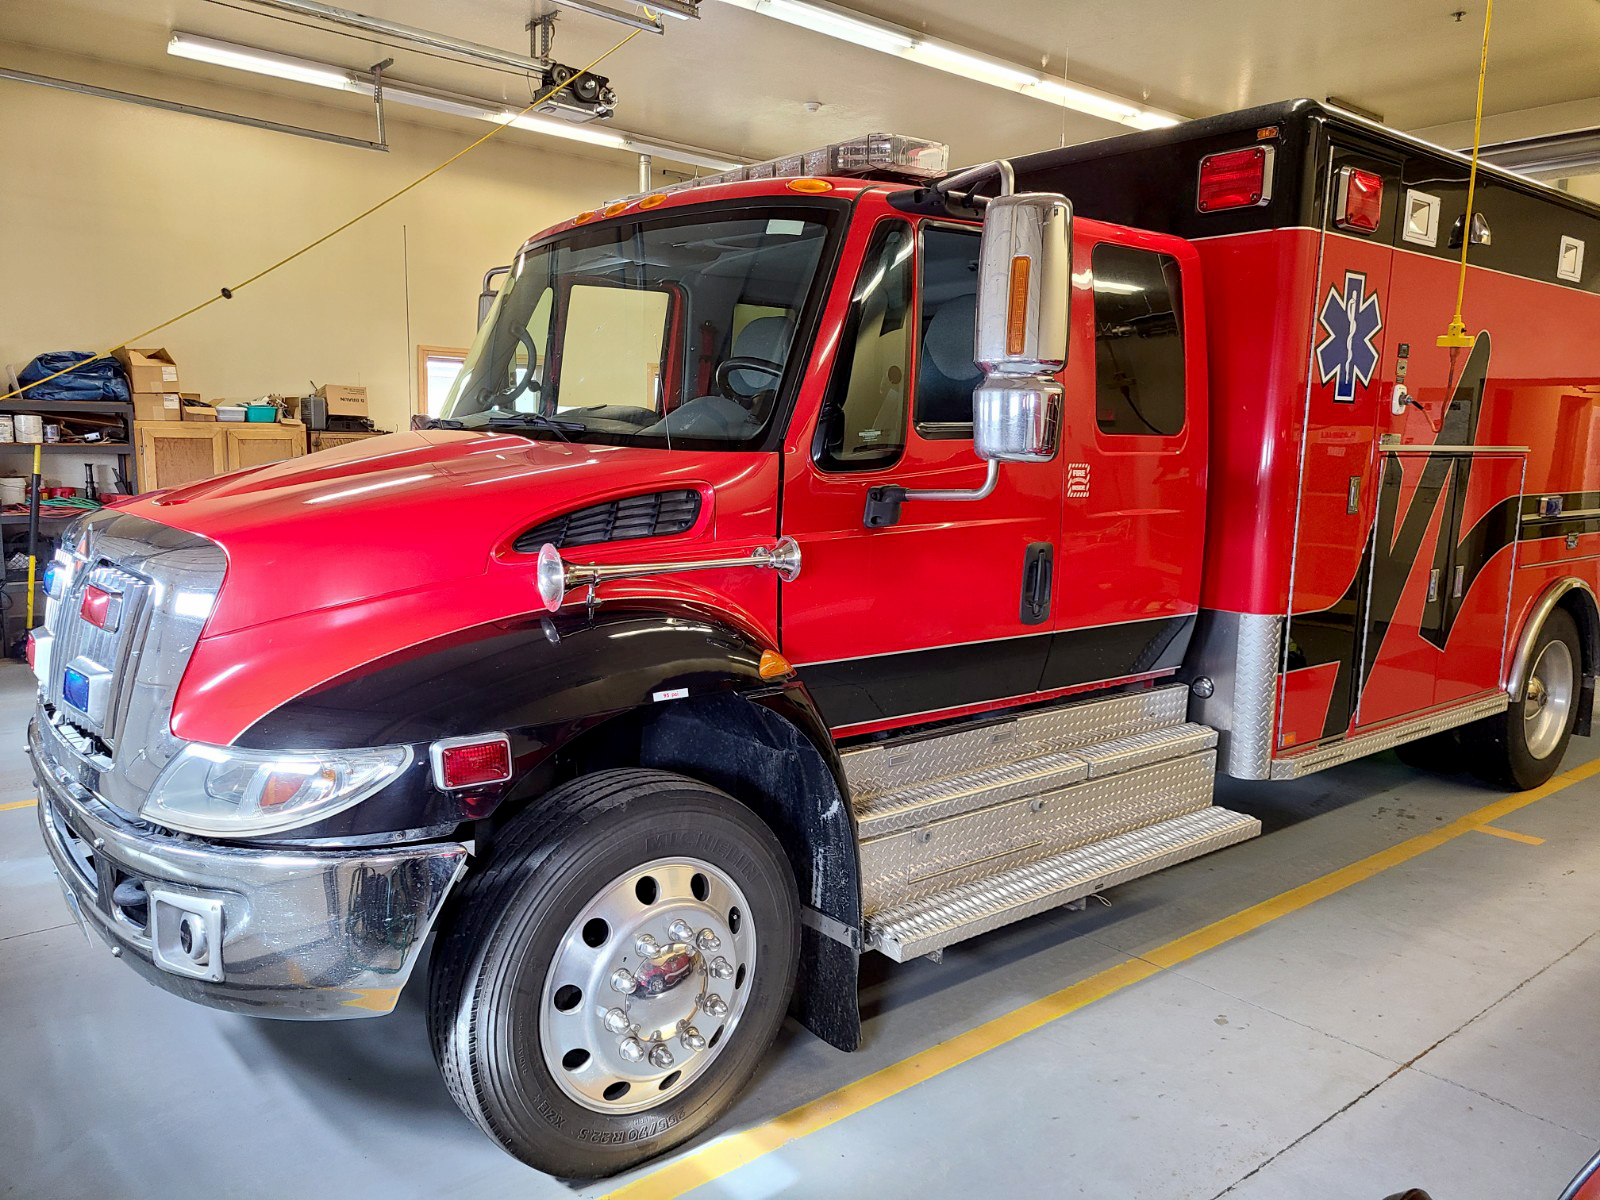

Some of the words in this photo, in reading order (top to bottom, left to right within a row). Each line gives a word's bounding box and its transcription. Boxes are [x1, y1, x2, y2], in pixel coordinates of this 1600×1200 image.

[1072, 469, 1086, 477] FIRE
[646, 831, 759, 882] MICHELIN
[627, 1106, 686, 1141] 255/70
